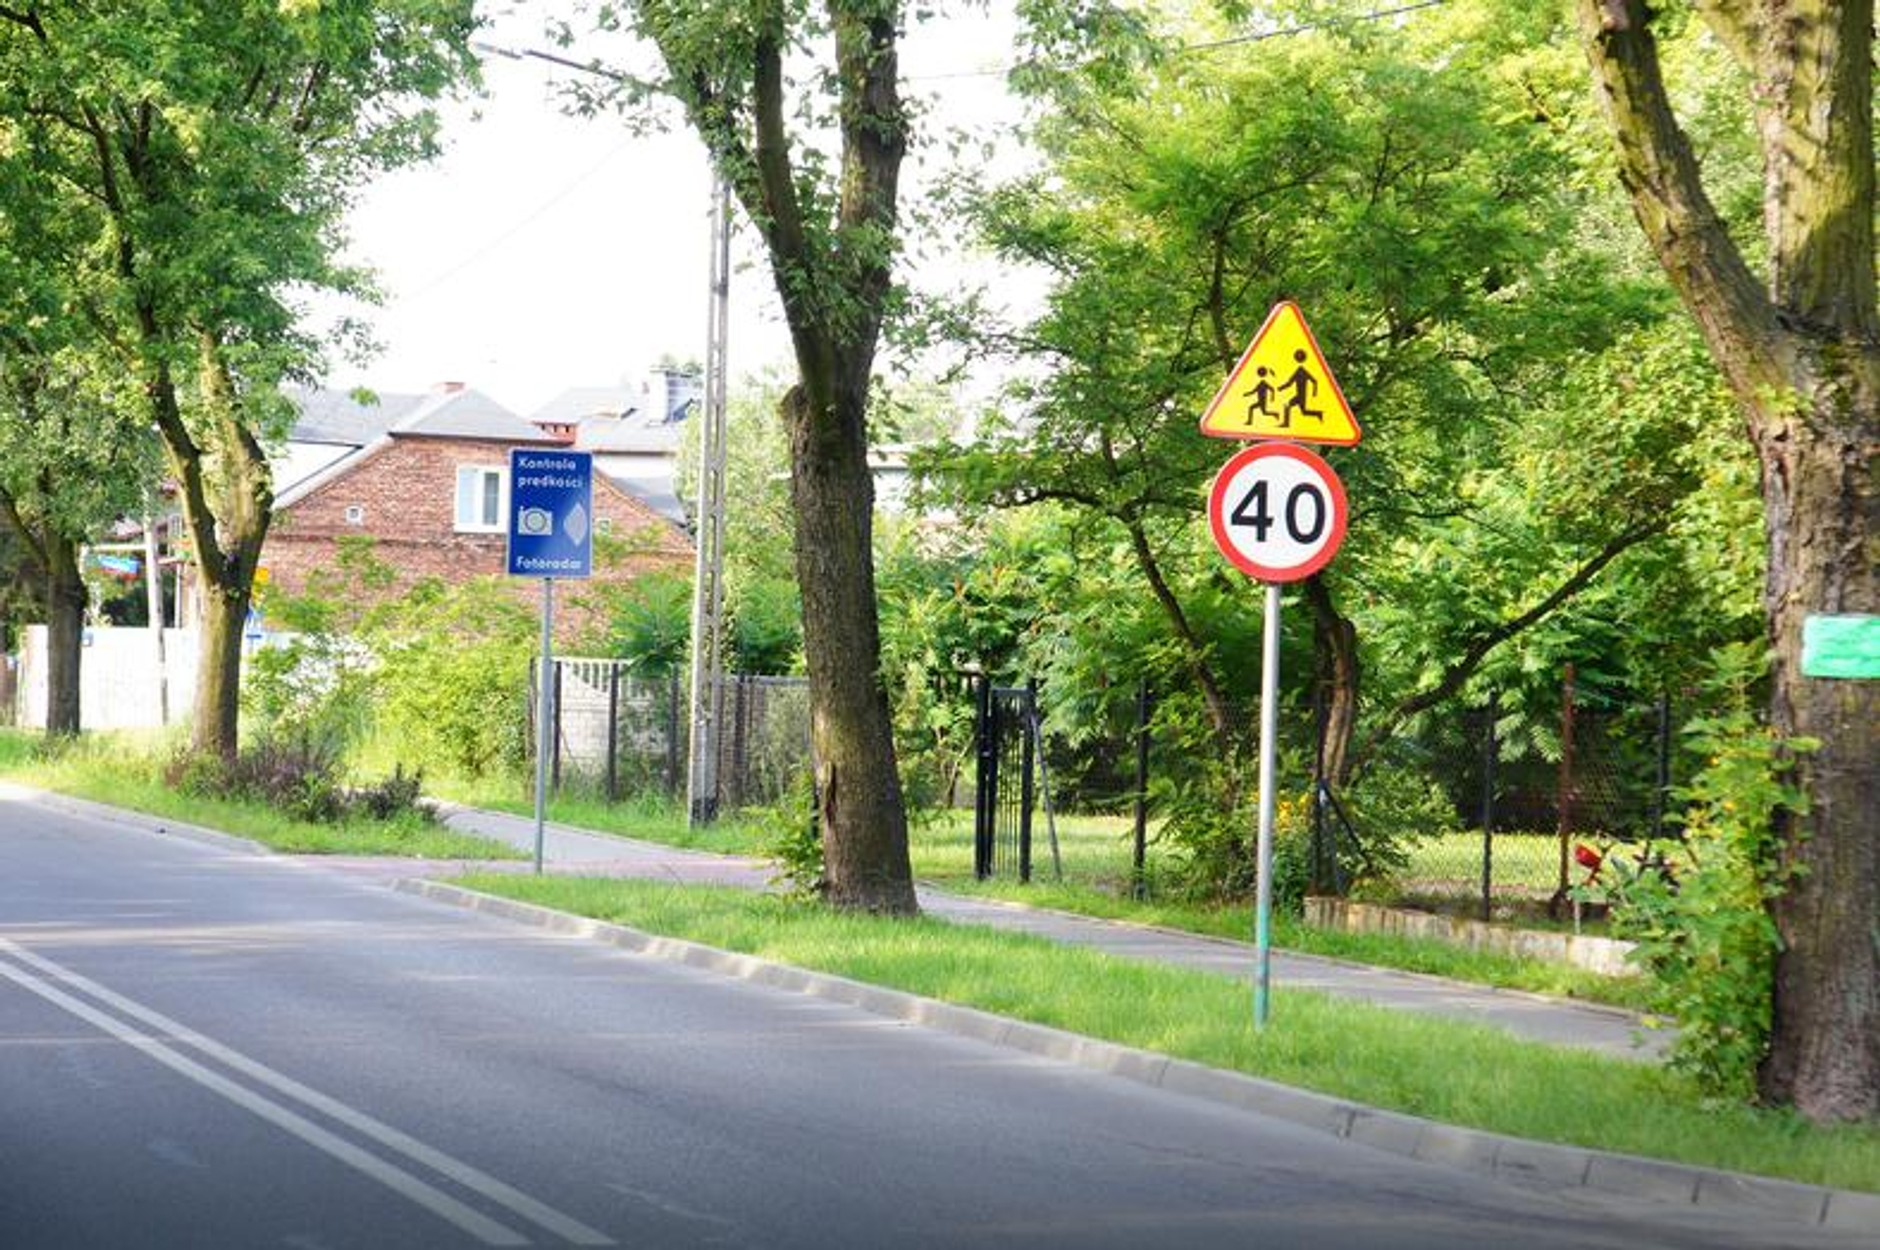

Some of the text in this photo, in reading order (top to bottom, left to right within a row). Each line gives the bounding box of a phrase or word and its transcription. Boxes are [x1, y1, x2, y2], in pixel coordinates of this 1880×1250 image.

[518, 458, 576, 470] Kontrola
[1231, 480, 1326, 544] 40
[516, 556, 582, 569] Fotoradar
